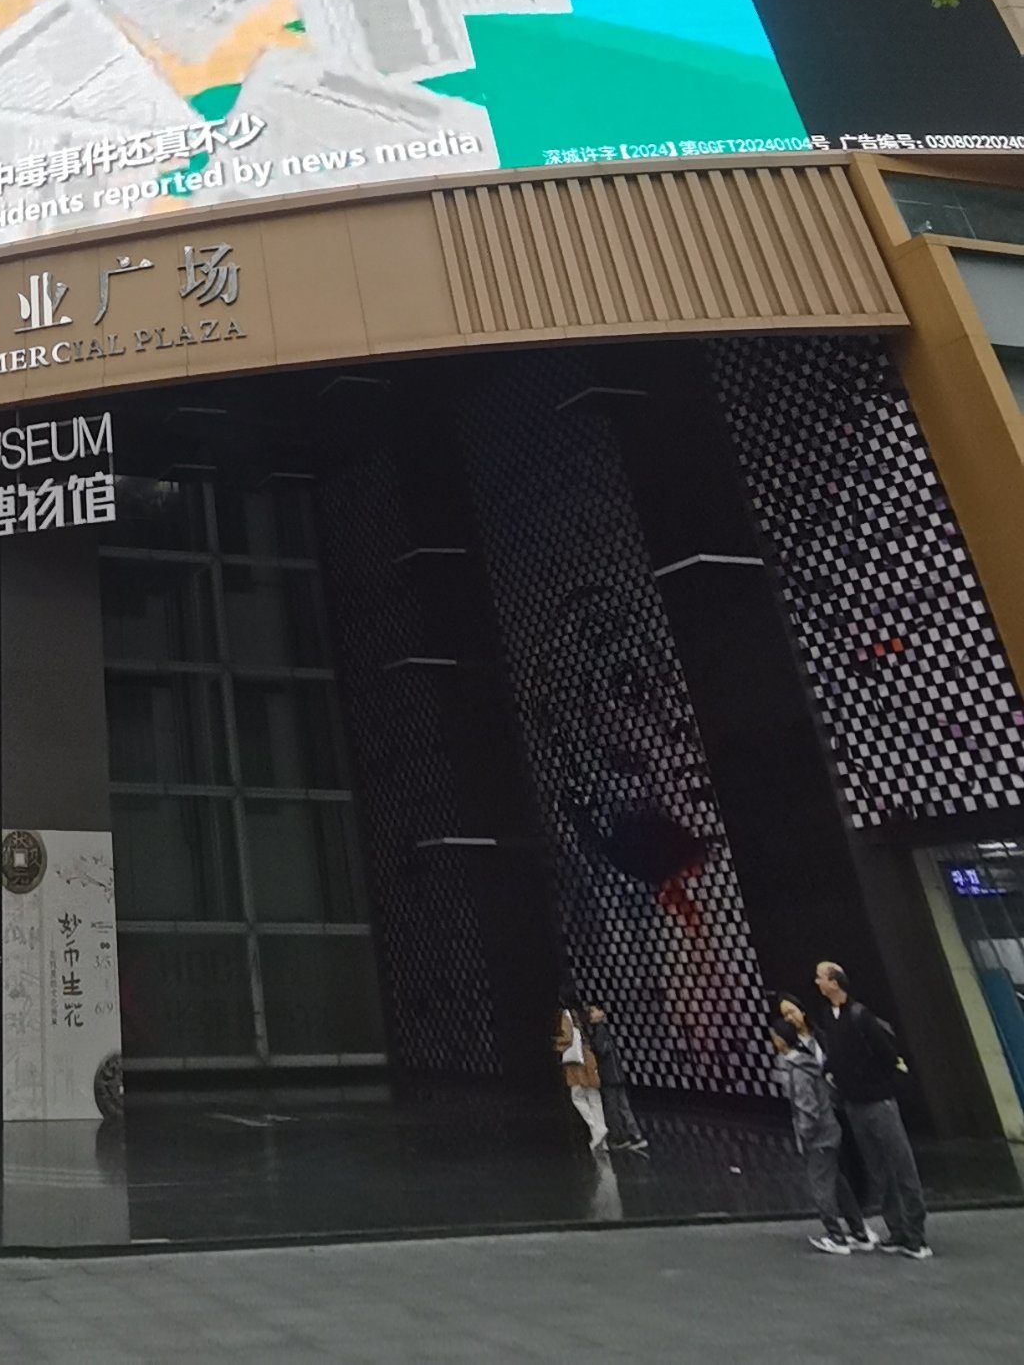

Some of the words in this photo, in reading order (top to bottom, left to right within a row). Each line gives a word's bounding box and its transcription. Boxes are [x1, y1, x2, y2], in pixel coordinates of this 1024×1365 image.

[93, 161, 223, 210] reported
[234, 157, 274, 187] by
[281, 146, 367, 176] news
[375, 127, 482, 165] media
[134, 317, 247, 353] PLAZA
[57, 912, 84, 1028] 妙币生花
